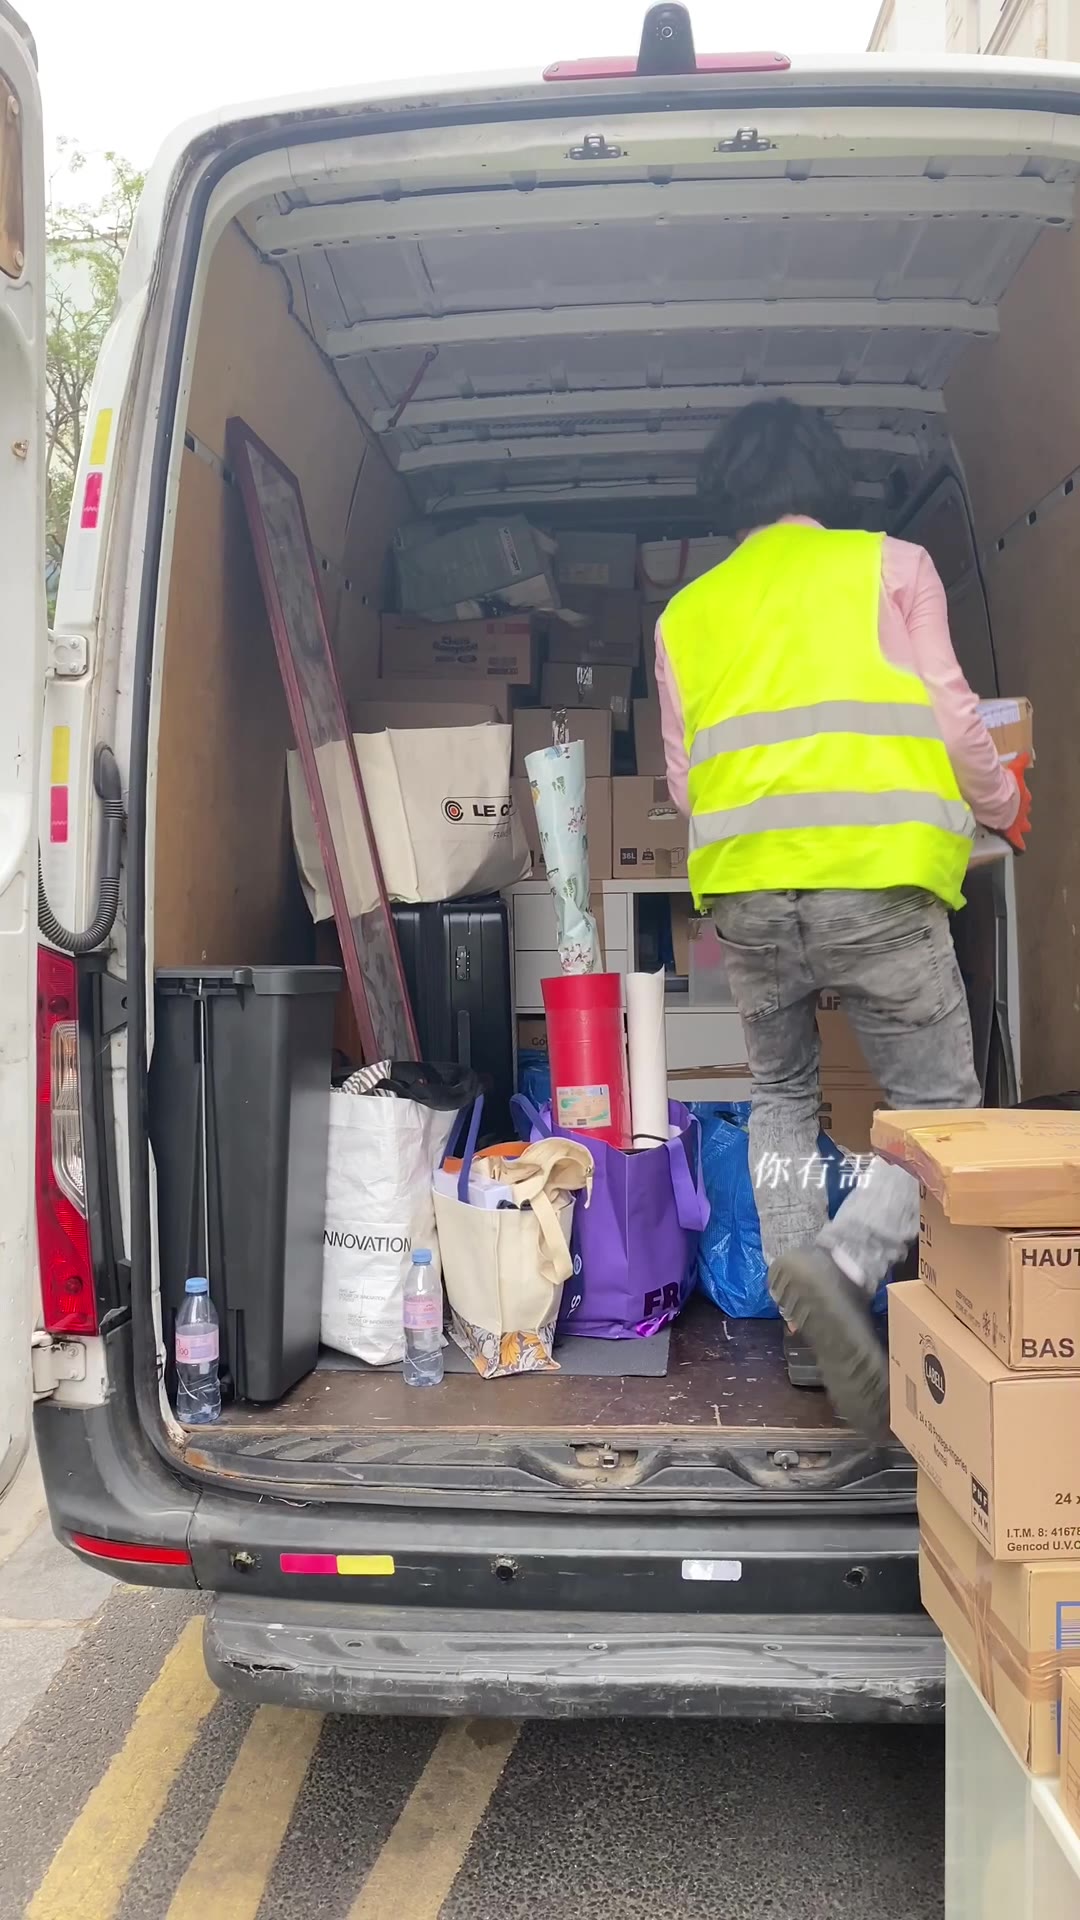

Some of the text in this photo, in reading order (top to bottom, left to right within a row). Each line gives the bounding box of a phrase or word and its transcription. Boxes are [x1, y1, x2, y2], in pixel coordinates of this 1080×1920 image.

[472, 804, 497, 817] LE
[919, 1258, 937, 1287] DOWN
[643, 1281, 681, 1318] FR
[1021, 1338, 1075, 1358] BAS
[925, 1361, 945, 1394] LABELL
[1055, 1492, 1072, 1505] 24
[1007, 1528, 1035, 1538] I.T.M.
[1037, 1527, 1048, 1538] 8:
[1007, 1541, 1050, 1552] Gencod
